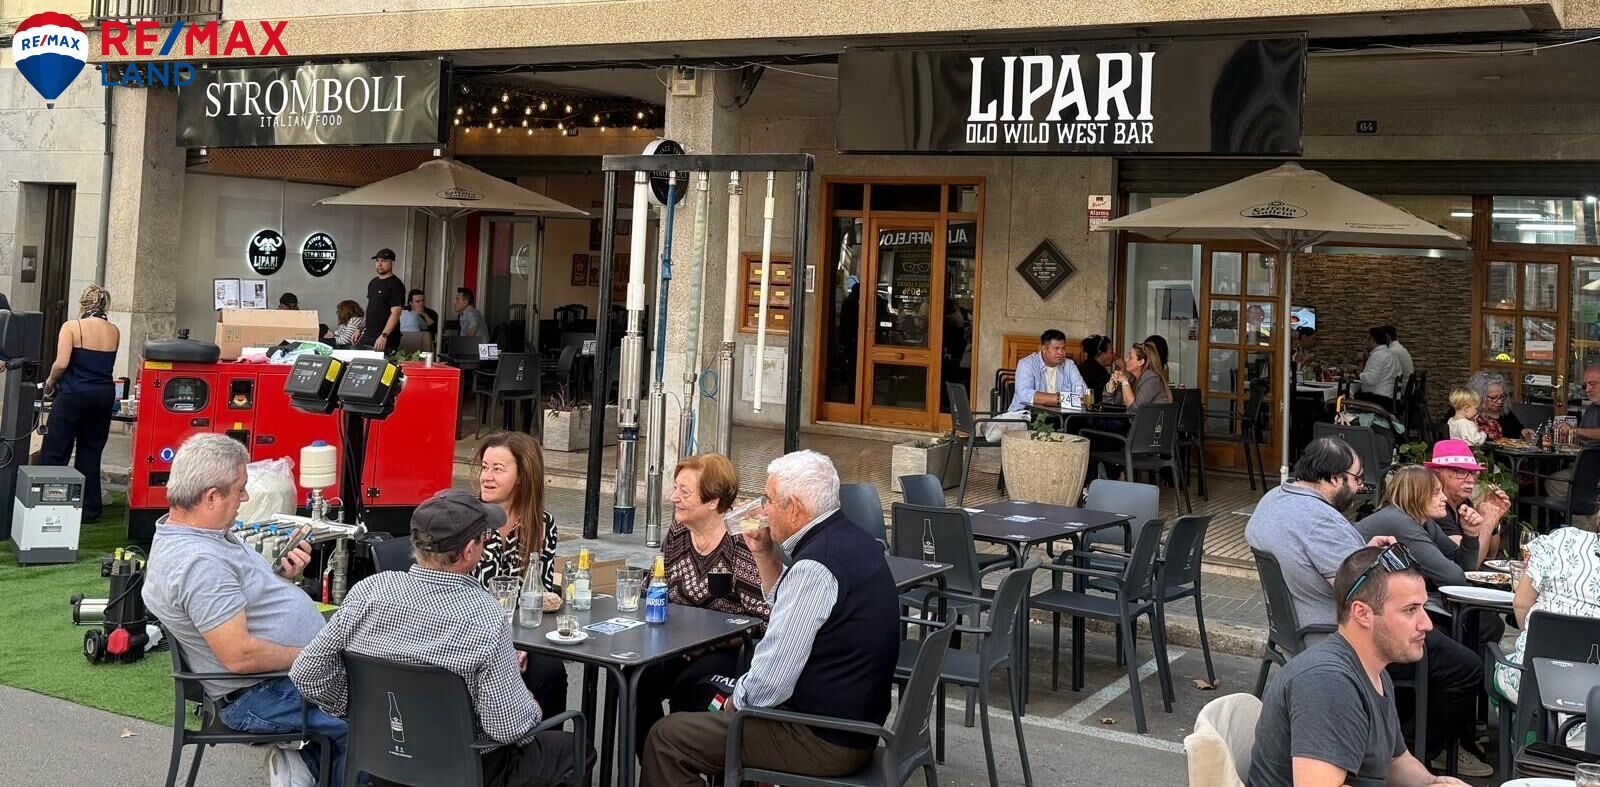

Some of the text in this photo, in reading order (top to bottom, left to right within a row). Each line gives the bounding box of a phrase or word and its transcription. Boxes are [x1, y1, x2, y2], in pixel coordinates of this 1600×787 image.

[205, 75, 406, 118] STROMBOLI
[967, 52, 1156, 121] LIPARI
[259, 114, 343, 128] ITALIAN FOOD
[966, 121, 1154, 144] OLD WILD WEST BAR
[253, 255, 278, 267] LIPARI
